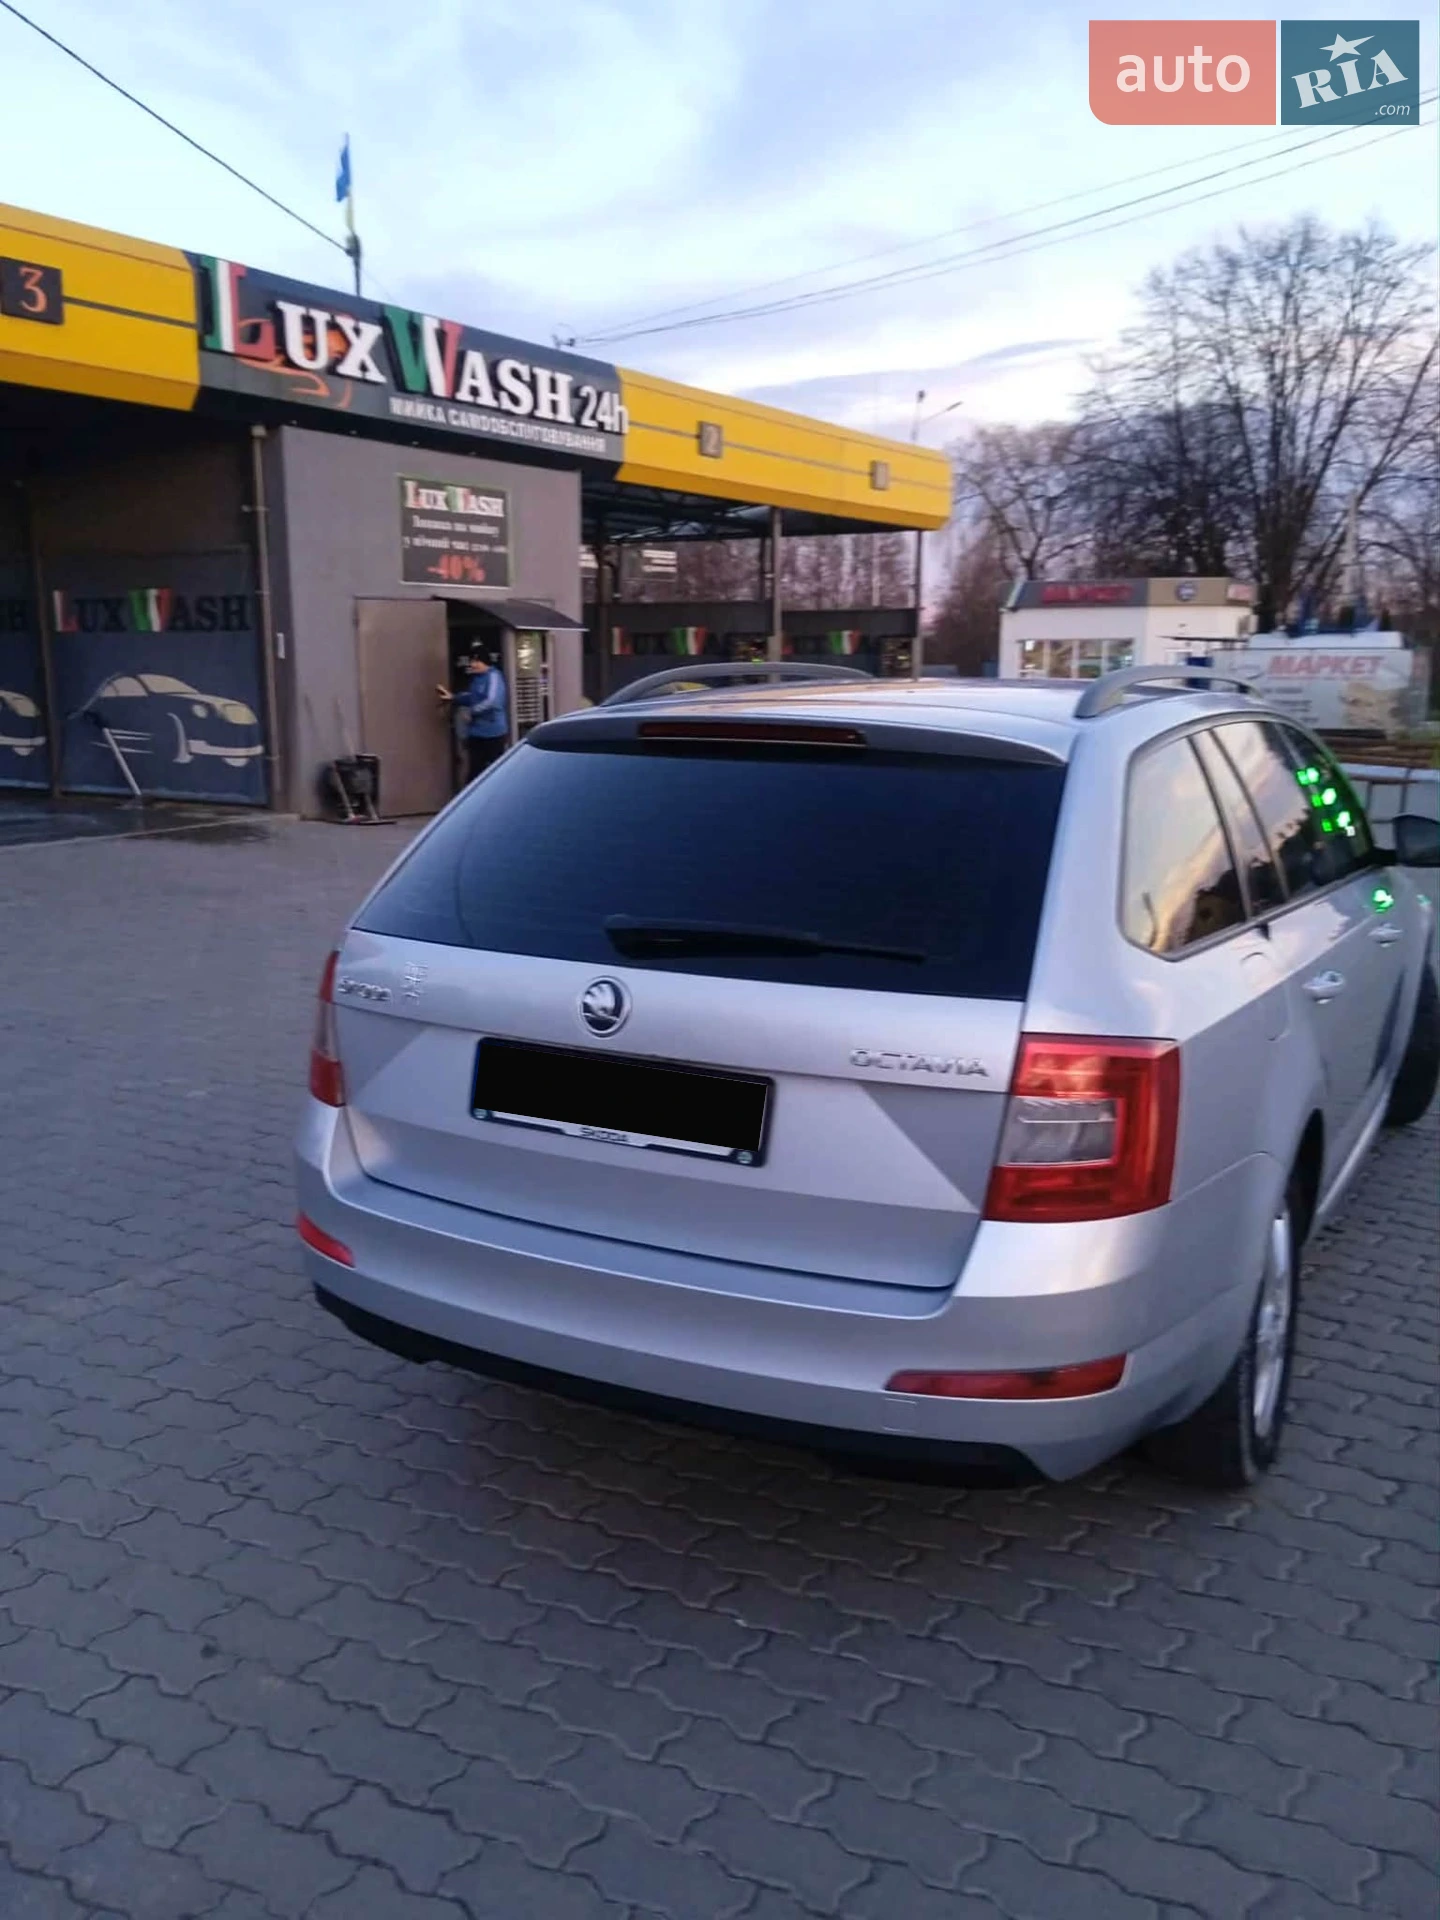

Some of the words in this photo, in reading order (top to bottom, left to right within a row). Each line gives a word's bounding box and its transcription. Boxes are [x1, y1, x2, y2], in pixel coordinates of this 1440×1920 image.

[19, 266, 47, 313] 3
[579, 386, 629, 435] 24h
[850, 1049, 990, 1077] OCTAVIA
